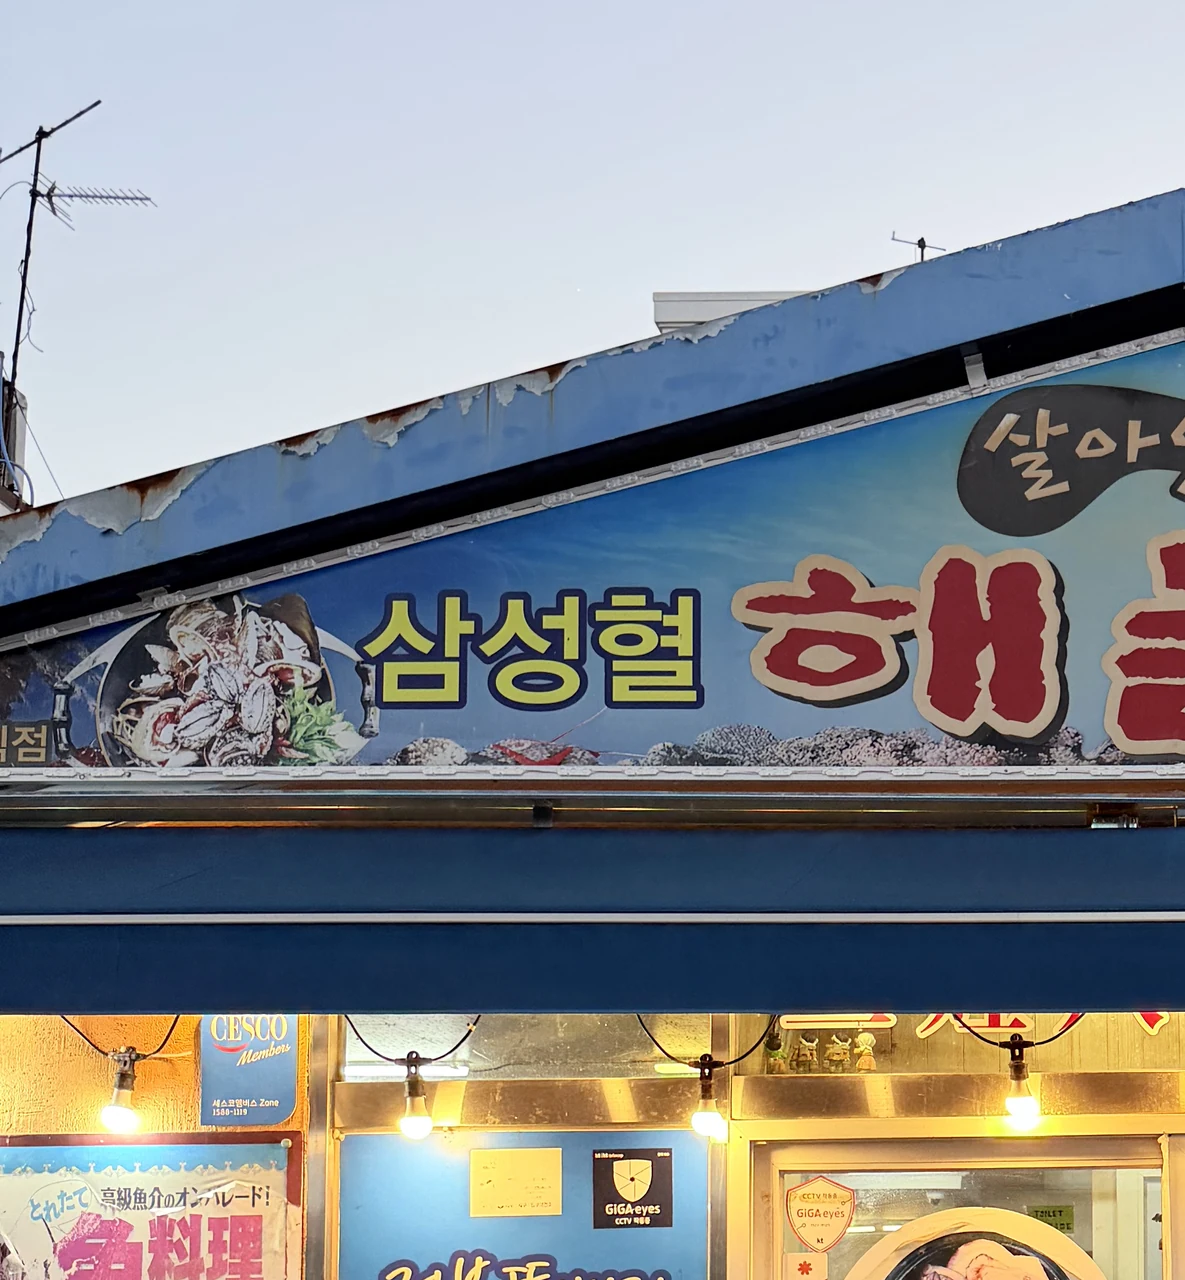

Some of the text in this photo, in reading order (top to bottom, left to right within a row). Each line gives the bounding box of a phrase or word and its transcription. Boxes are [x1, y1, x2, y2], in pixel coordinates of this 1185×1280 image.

[361, 591, 701, 707] 삼성혈
[210, 1014, 287, 1041] CESCO
[236, 1041, 291, 1066] Members
[260, 1099, 279, 1107] Zone
[30, 1186, 90, 1223] とれたて
[615, 1217, 632, 1225] CCTV
